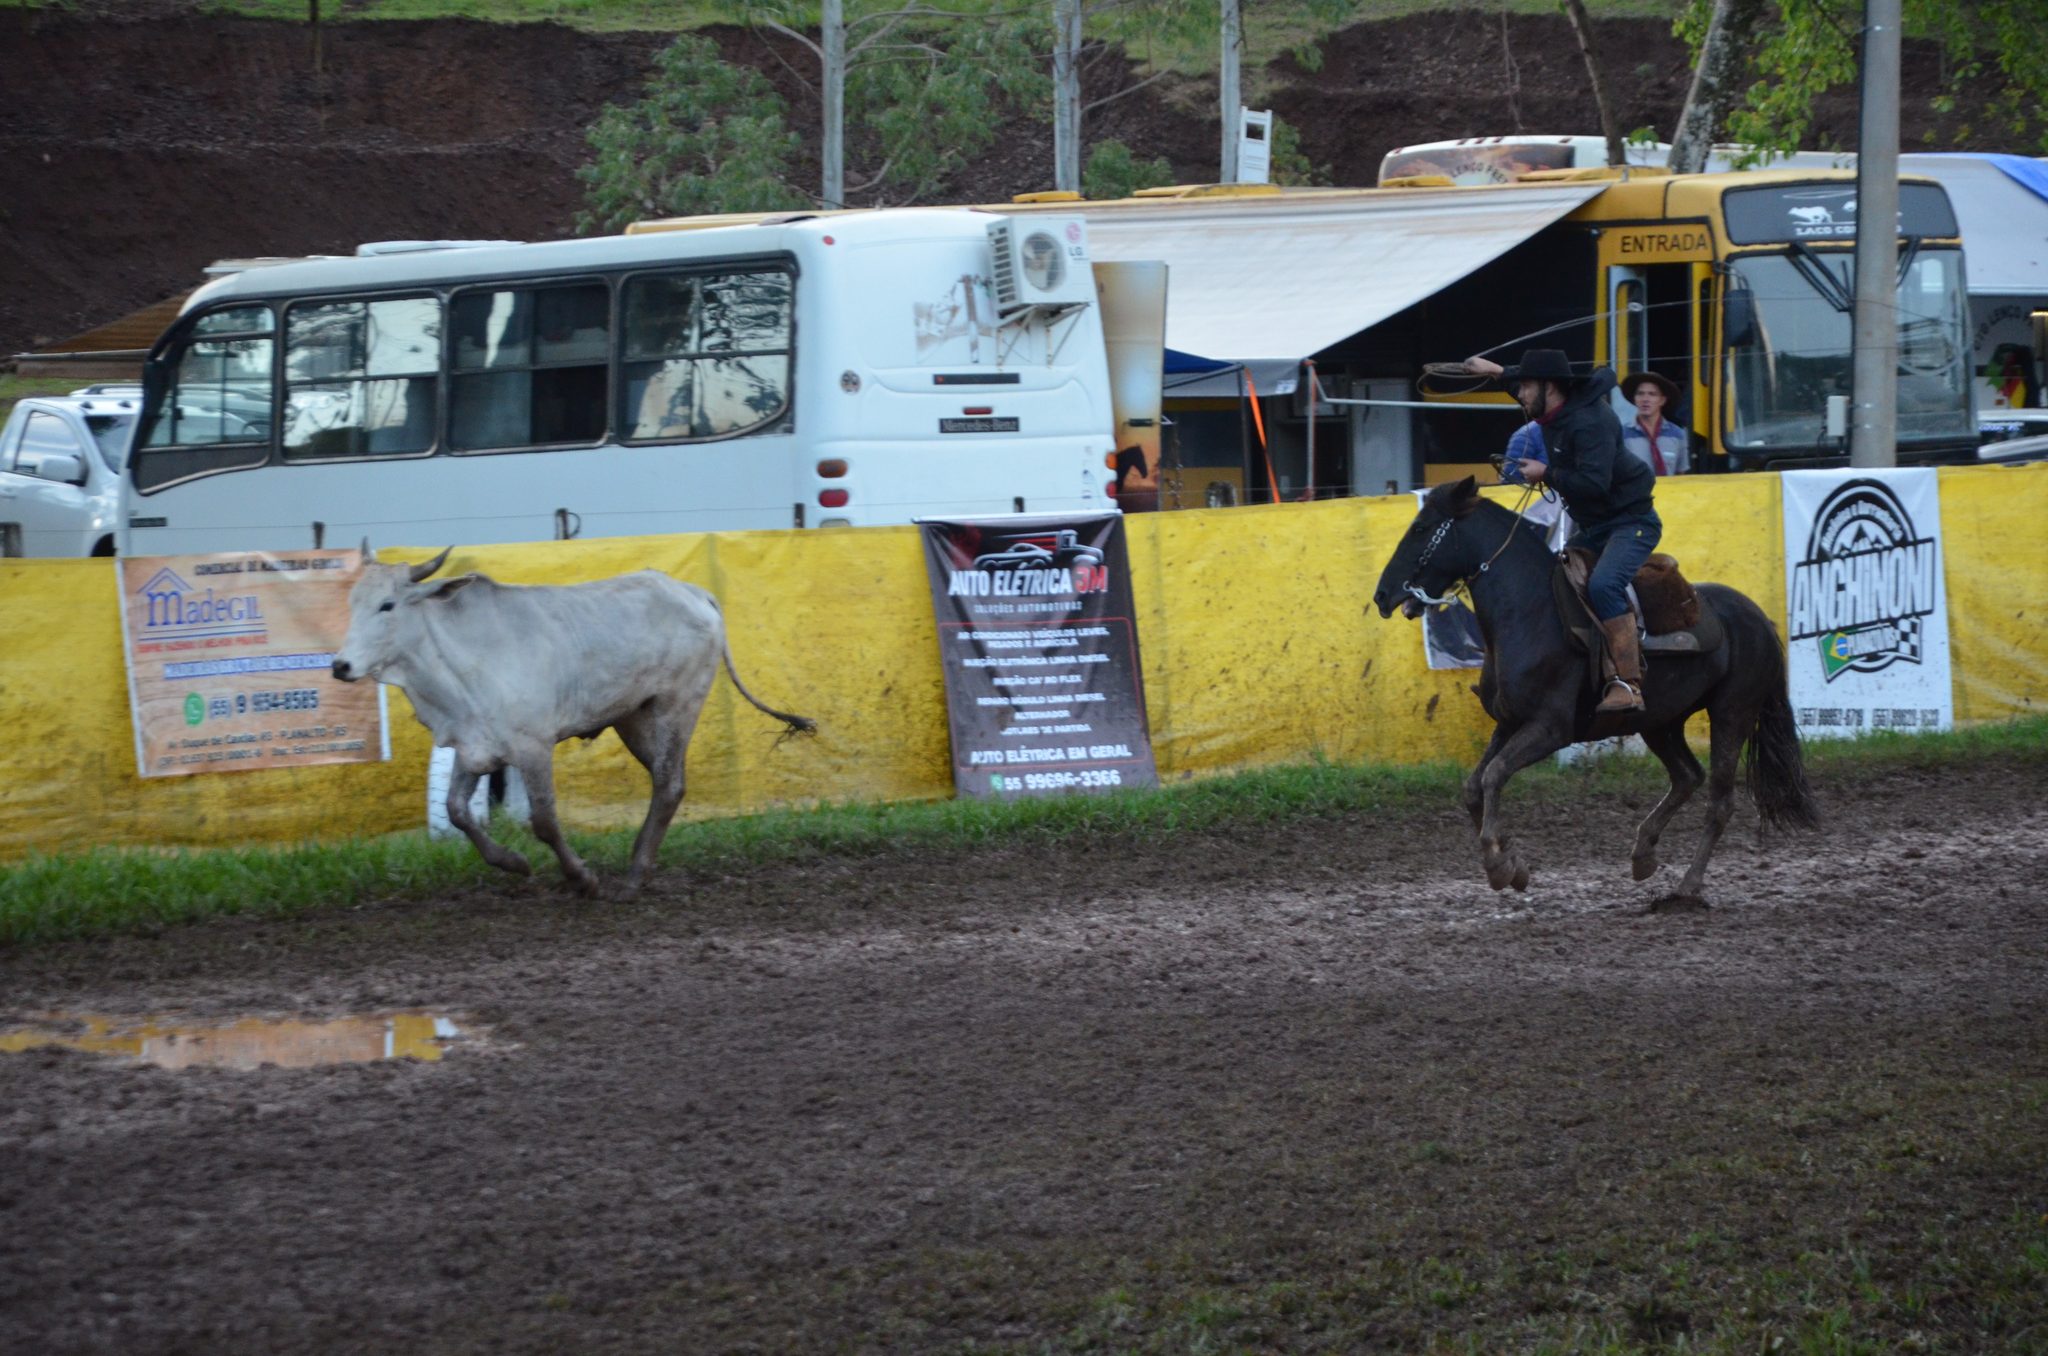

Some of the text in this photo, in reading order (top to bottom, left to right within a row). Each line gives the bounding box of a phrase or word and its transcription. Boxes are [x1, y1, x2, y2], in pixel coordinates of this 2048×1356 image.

[1069, 246, 1084, 256] LG
[1621, 233, 1709, 254] ENTRADA
[948, 562, 1109, 596] AUTO ELÉTRICA 3M
[1017, 601, 1083, 613] AUTOMOTIVAS
[970, 744, 1133, 764] AUTO ELÉTRICA EM GERAL
[1004, 777, 1023, 791] 55
